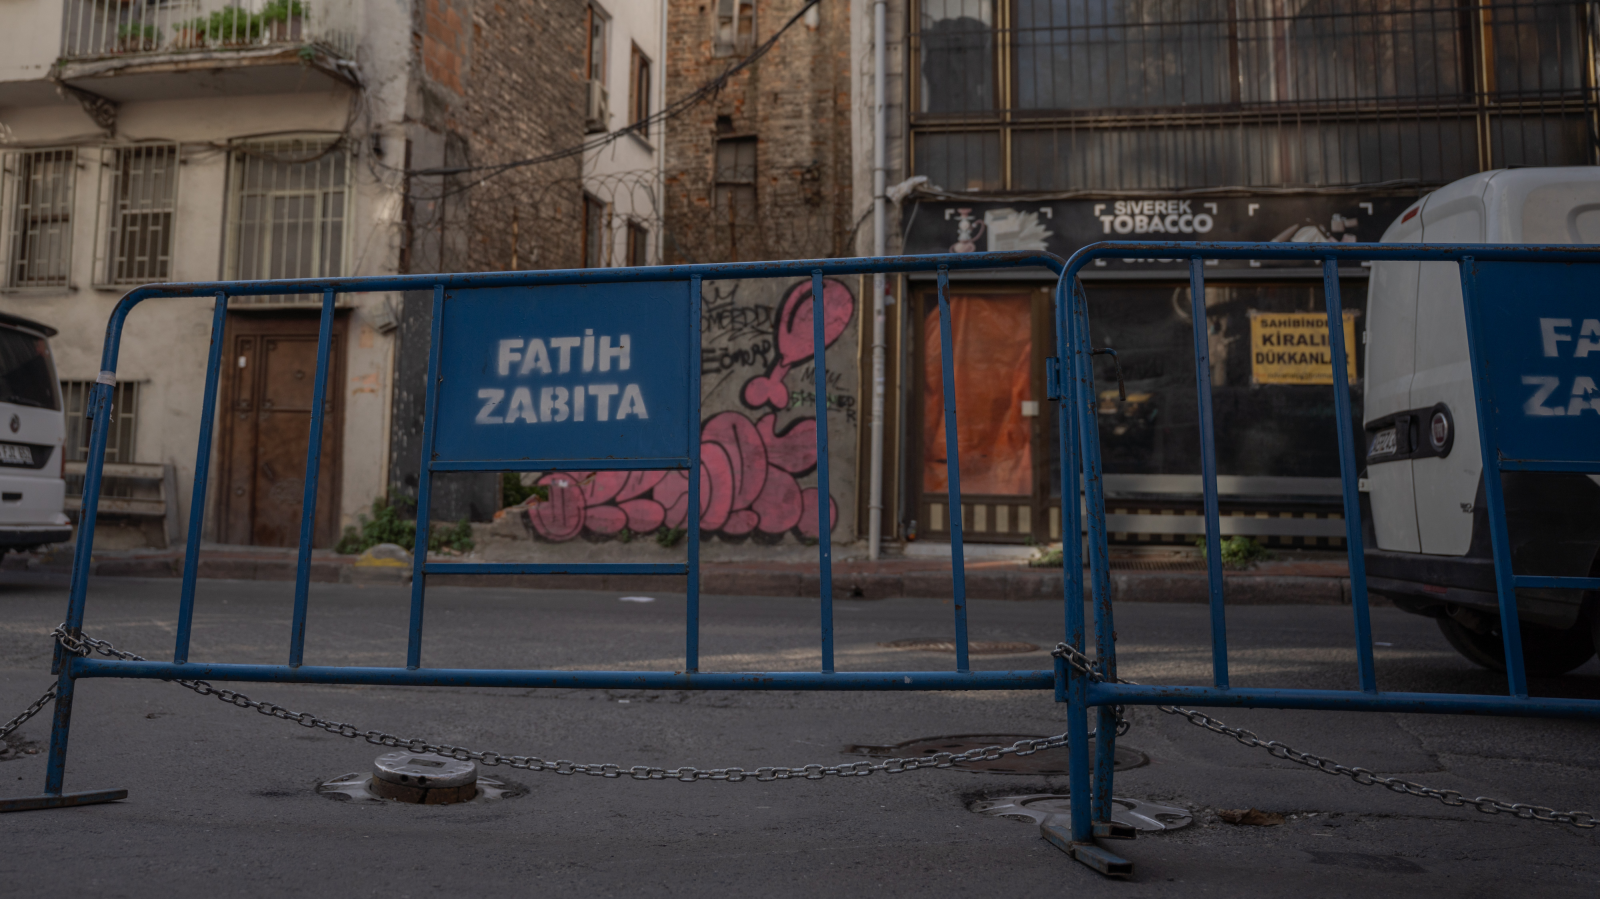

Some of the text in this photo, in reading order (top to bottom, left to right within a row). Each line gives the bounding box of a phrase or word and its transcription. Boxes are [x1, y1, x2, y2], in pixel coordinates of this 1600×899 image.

[1099, 213, 1214, 234] TOBACCO
[1260, 316, 1329, 329] SAHİBİND
[1262, 330, 1330, 347] KİRALI
[498, 328, 631, 376] FATİH
[1255, 349, 1349, 365] DÜKKANL
[475, 382, 649, 425] ZABITA
